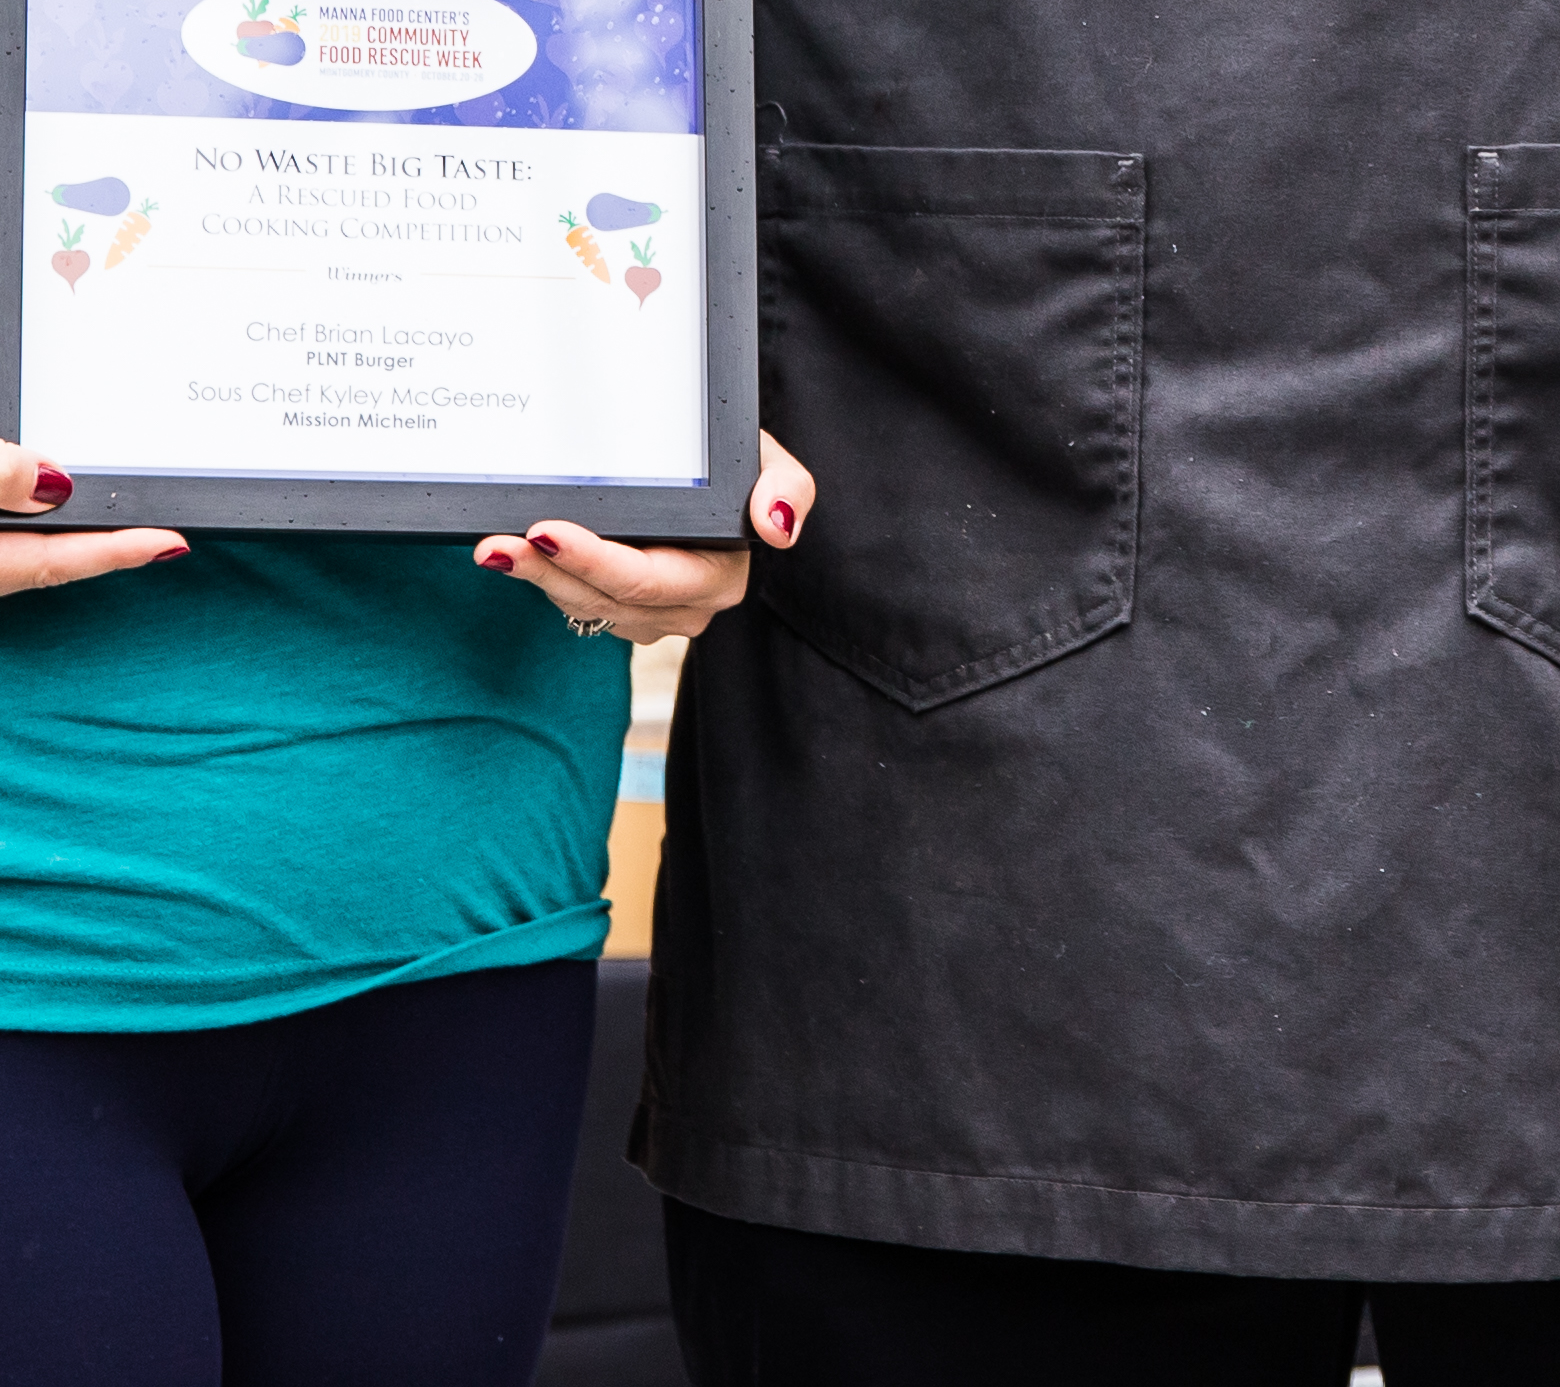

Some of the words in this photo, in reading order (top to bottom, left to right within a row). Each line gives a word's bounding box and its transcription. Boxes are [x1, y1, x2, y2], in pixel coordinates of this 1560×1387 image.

[319, 6, 367, 22] MANNA
[371, 8, 404, 23] FOOD
[408, 9, 470, 26] CENTER'S
[319, 24, 361, 43] 2019
[367, 26, 469, 46] COMMUNITY
[319, 45, 362, 64] FOOD
[368, 47, 431, 66] RESCUE
[436, 50, 483, 69] WEEK
[319, 67, 375, 79] MONTGOMERY
[377, 69, 410, 80] COUNTY
[248, 184, 265, 205] A
[327, 266, 403, 285] Winners
[246, 321, 307, 343] Chef
[315, 323, 373, 344] Brian
[383, 325, 474, 351] Lacayo
[306, 351, 348, 367] PLNT
[354, 352, 415, 372] Burger
[188, 381, 242, 403] Sous
[251, 382, 312, 404] Chef
[320, 384, 383, 409] Kyley
[391, 386, 531, 413] McGeeney
[282, 411, 351, 428] Mission
[357, 413, 438, 430] Michelin
